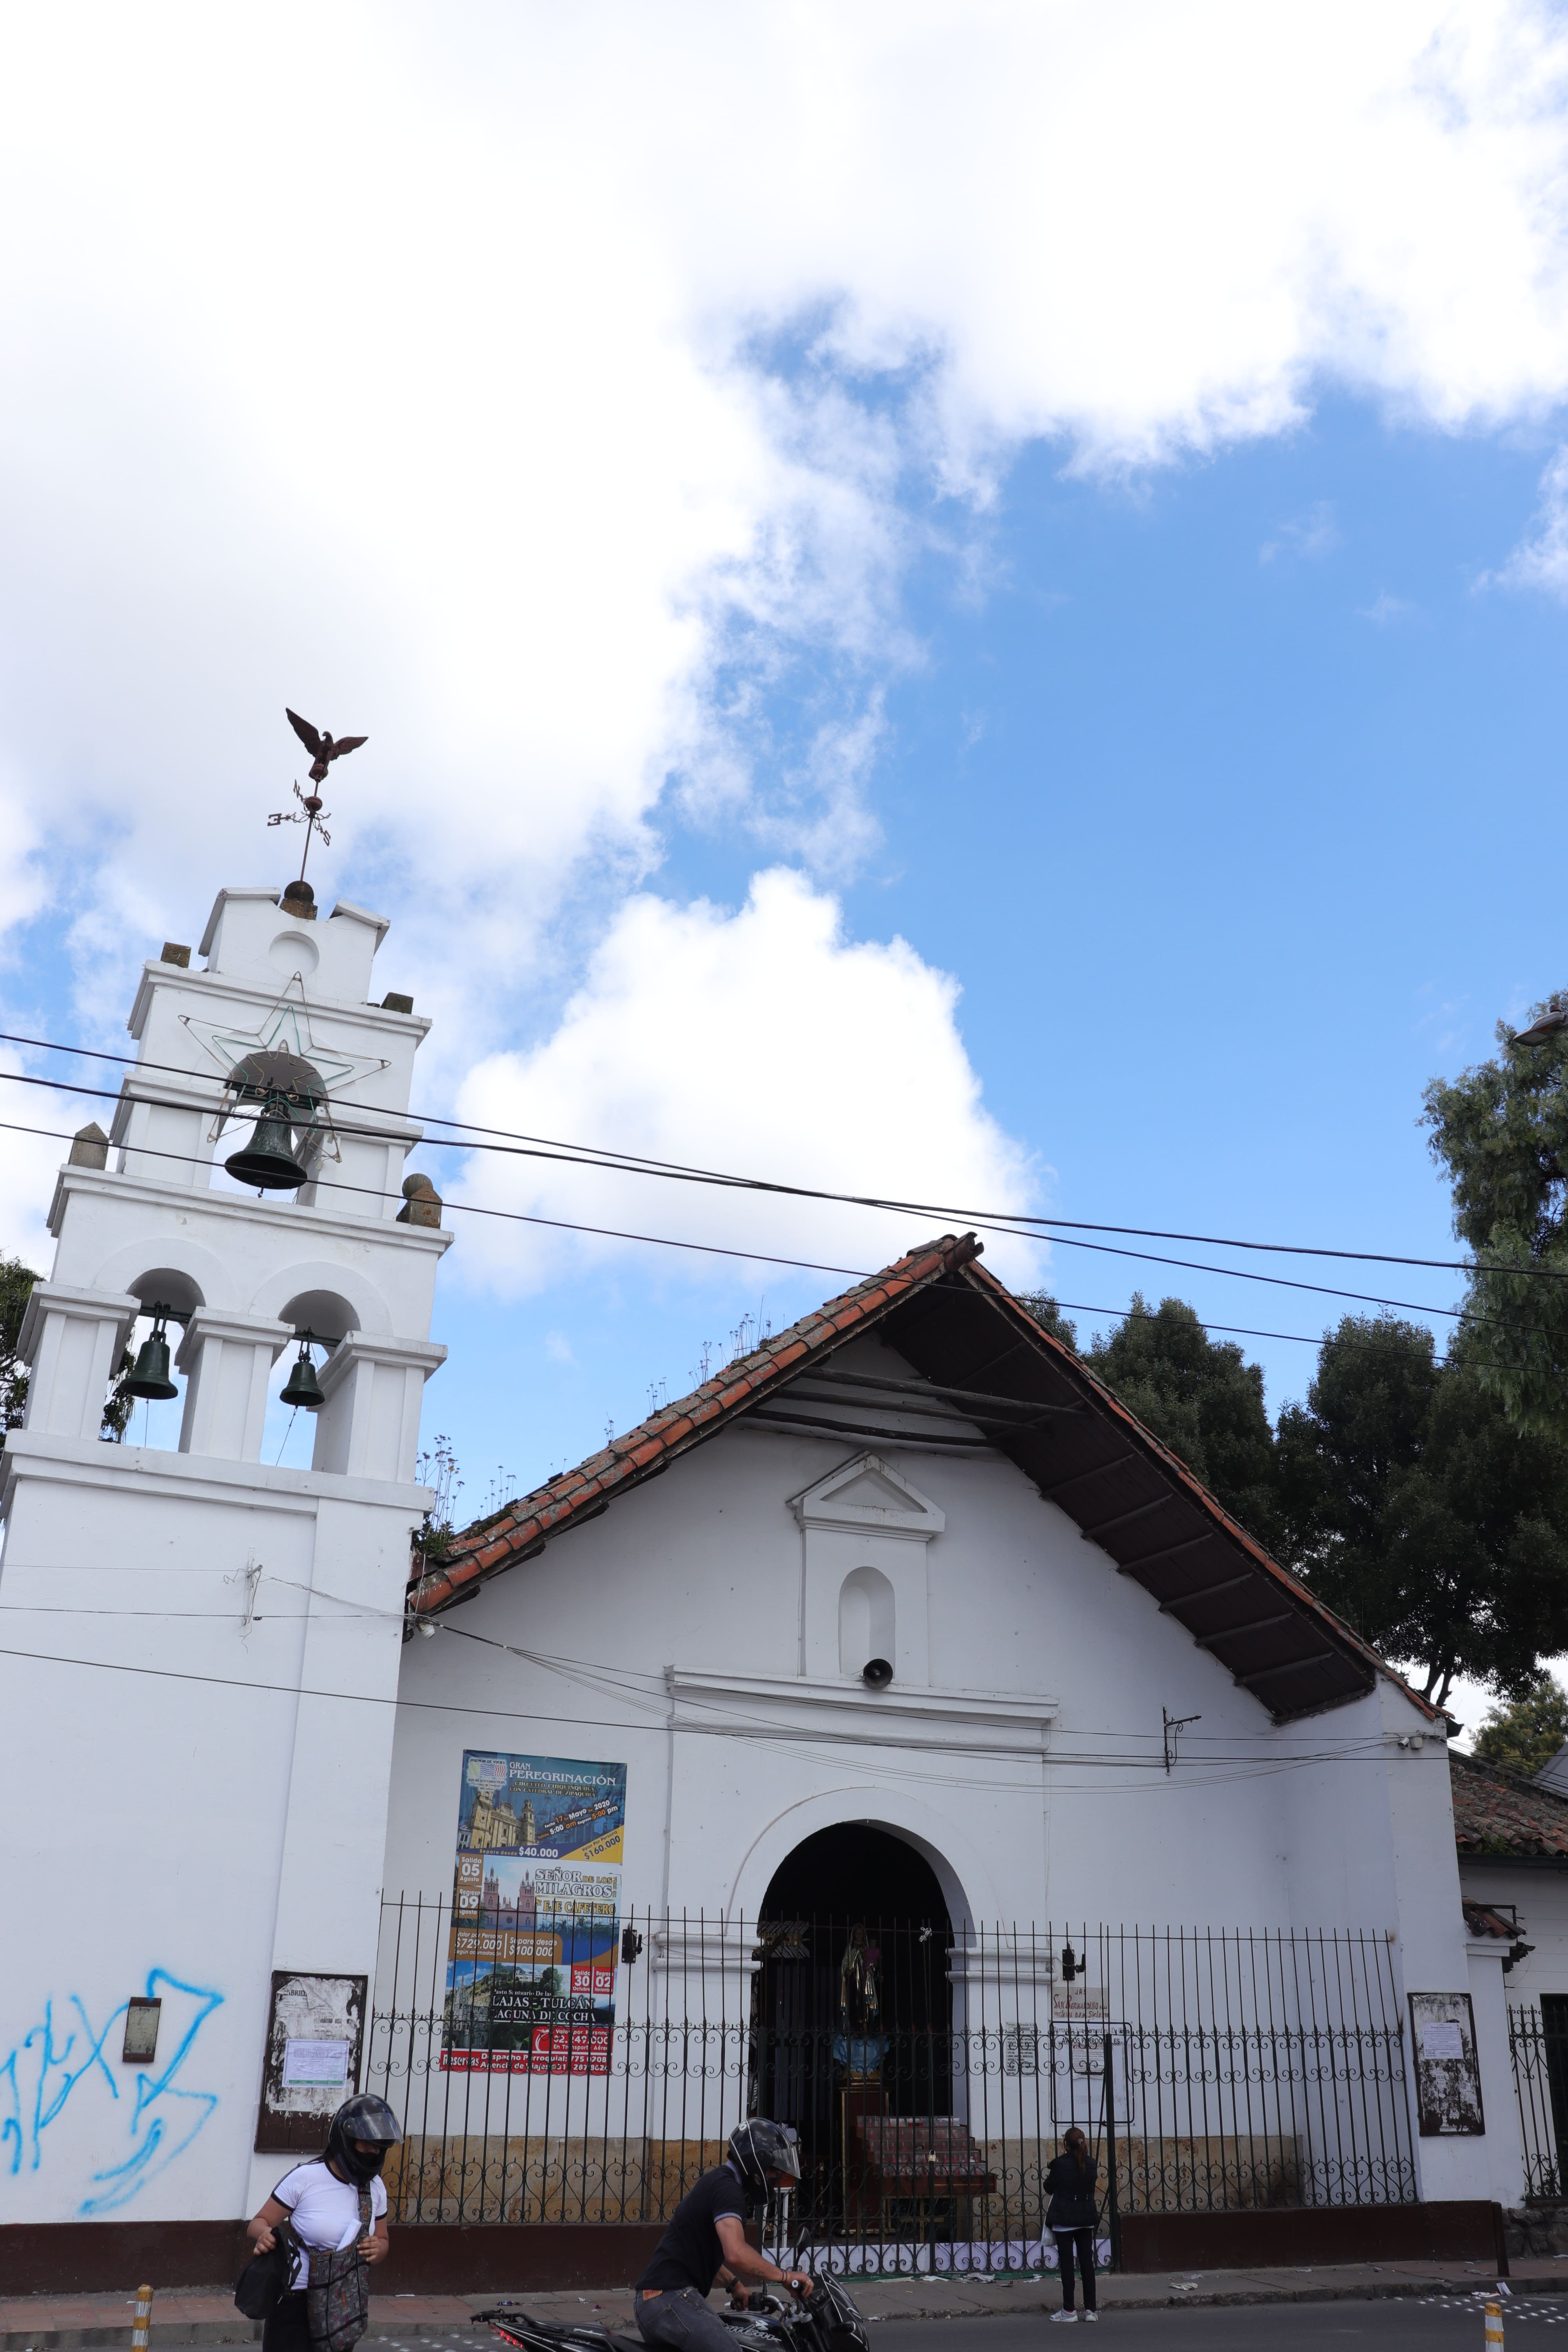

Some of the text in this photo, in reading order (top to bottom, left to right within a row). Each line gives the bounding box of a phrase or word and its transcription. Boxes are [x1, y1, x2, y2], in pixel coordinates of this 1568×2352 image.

[510, 1762, 530, 1770] GRAN
[509, 1769, 616, 1786] PEREGRINACIÓN
[548, 1784, 595, 1792] CHIQUINQUIRA
[568, 1808, 587, 1820] Mayo
[594, 1800, 610, 1810] 2020
[550, 1824, 564, 1835] 5:00
[592, 1809, 606, 1819] 5:00
[607, 1806, 618, 1815] pm
[601, 1831, 617, 1841] Persona
[519, 1846, 559, 1858] $40.000
[584, 1835, 621, 1860] $160.000
[462, 1864, 480, 1876] 05
[535, 1867, 582, 1882] SEÑOR
[535, 1882, 613, 1898] MILAGROS
[459, 1895, 479, 1909] 09
[543, 1900, 562, 1912] EJE
[564, 1902, 616, 1915] CAFETERO
[574, 1975, 611, 1987] 30 02
[492, 1996, 529, 2007] LAJAS
[541, 1996, 594, 2009] TULCÁN
